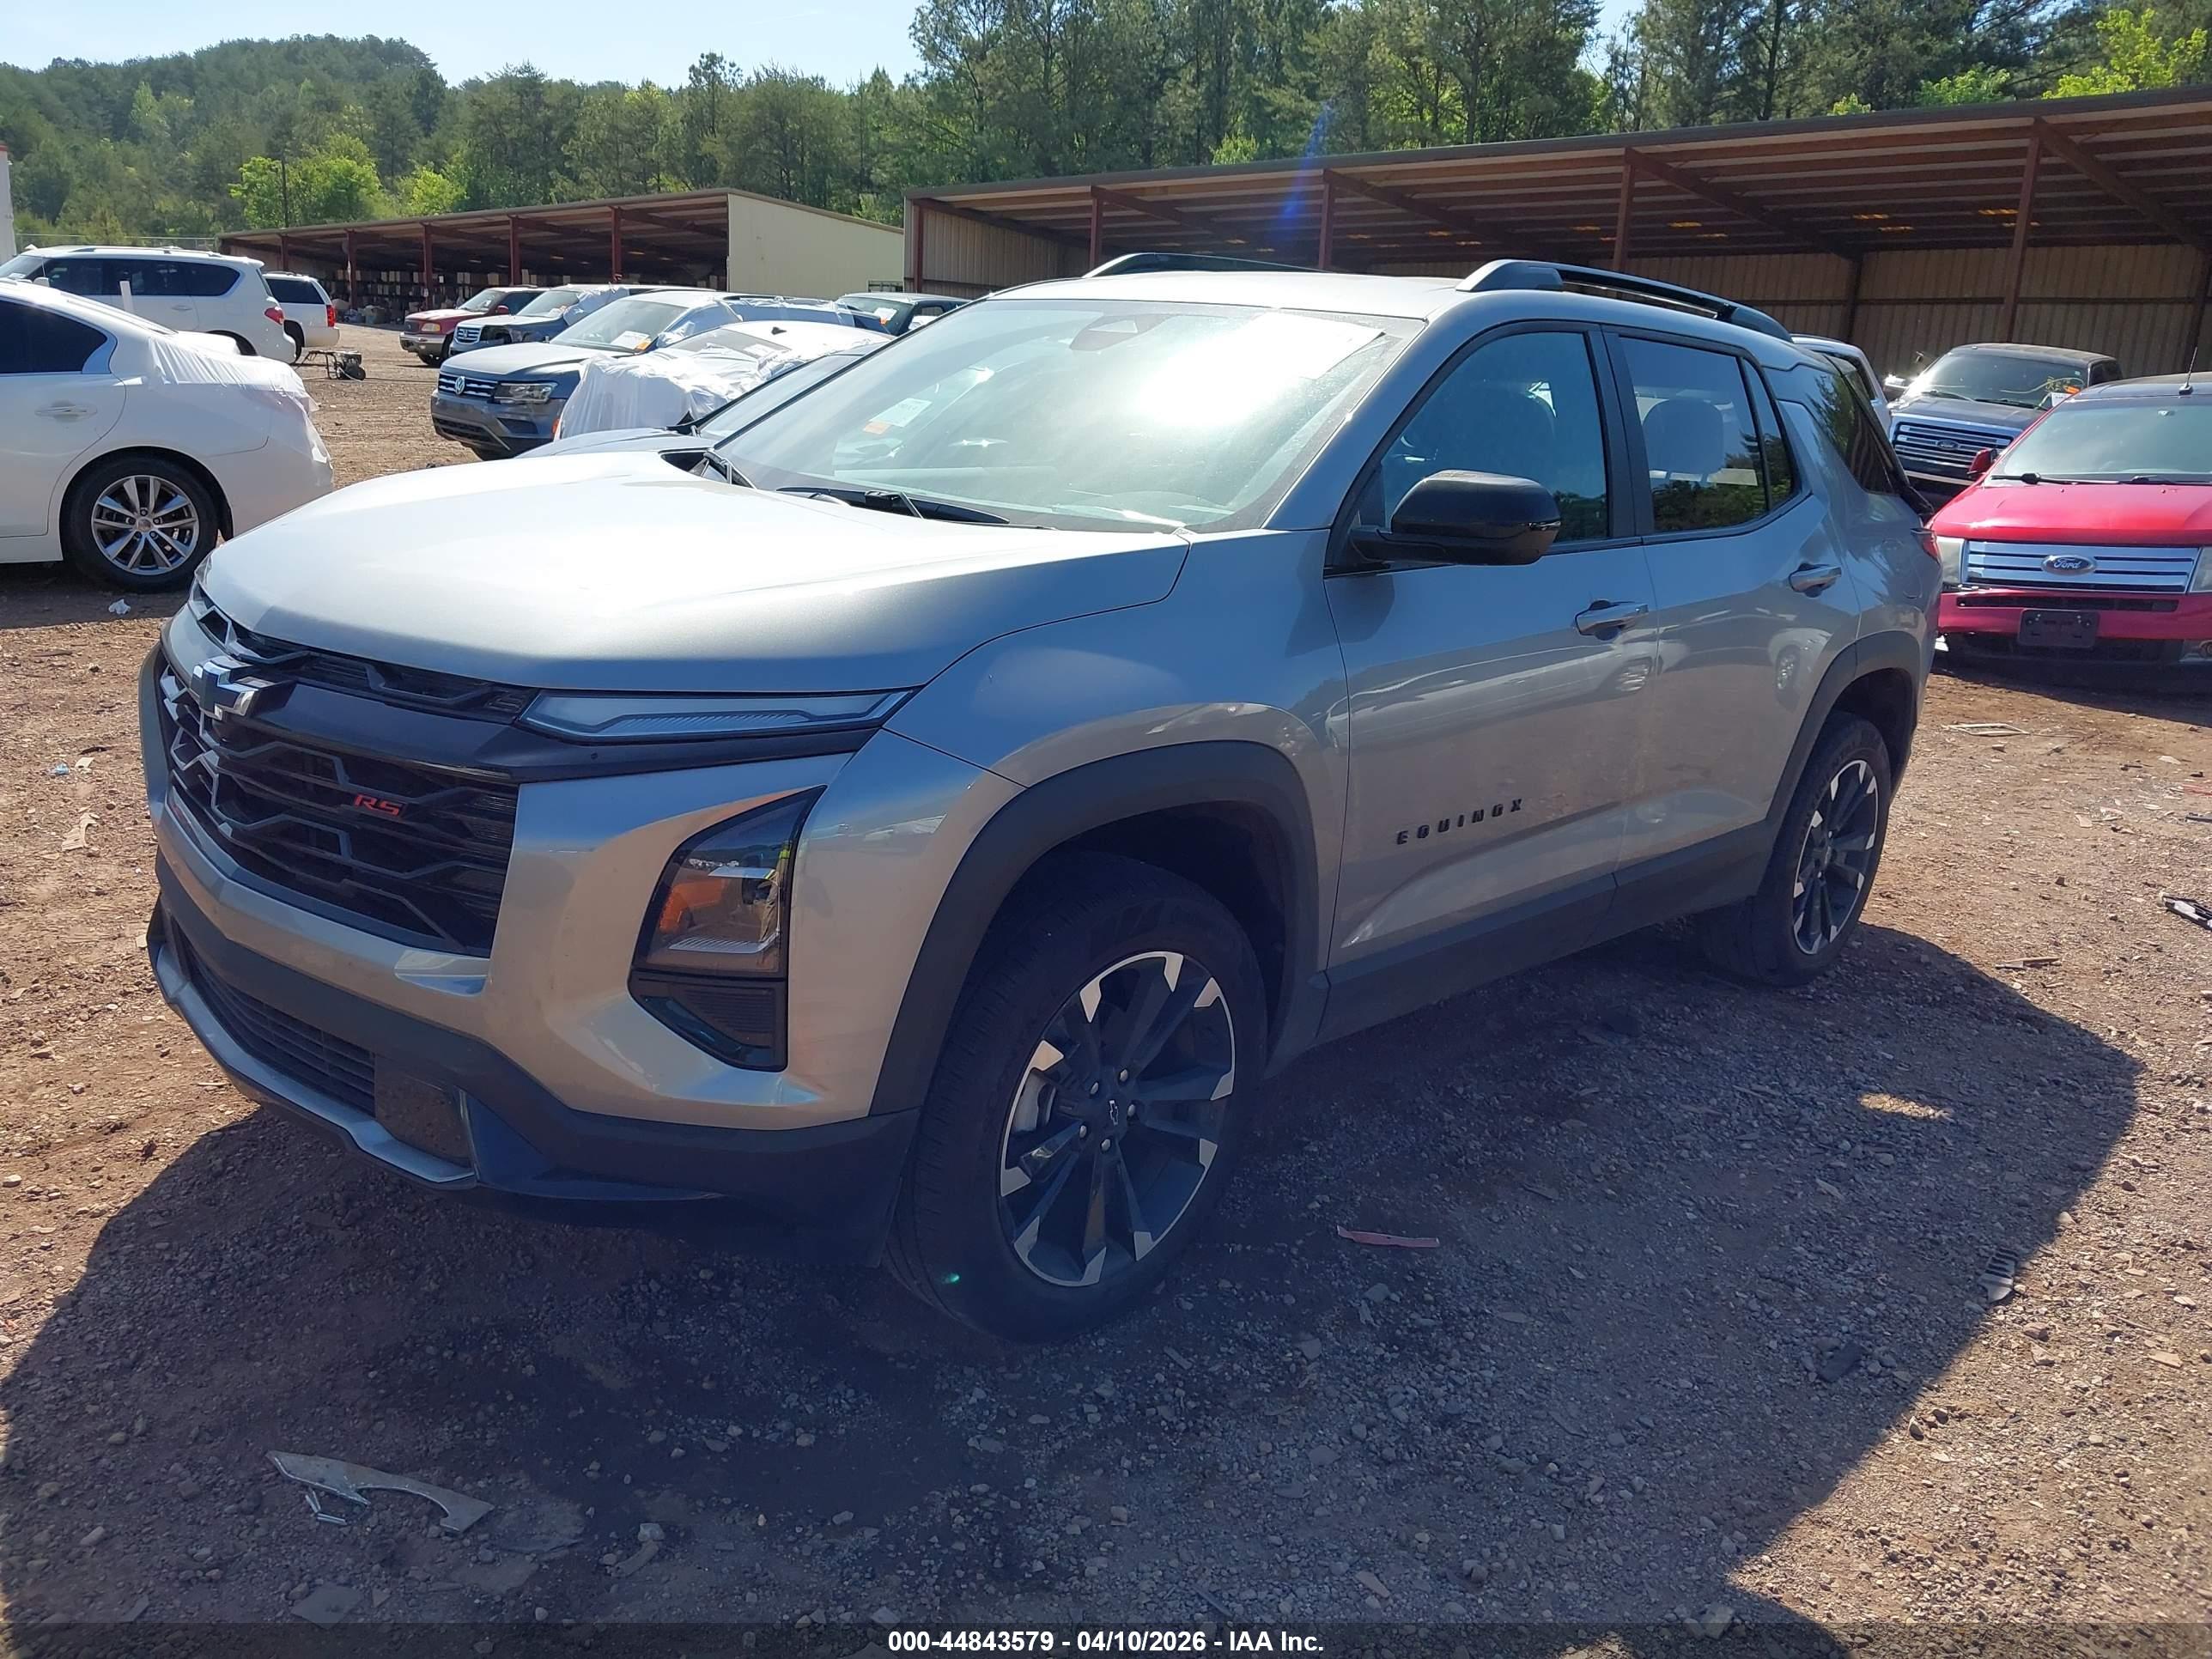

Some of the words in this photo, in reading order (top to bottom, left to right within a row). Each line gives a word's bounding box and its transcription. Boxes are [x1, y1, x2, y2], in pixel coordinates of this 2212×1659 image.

[2053, 557, 2082, 569] Ford
[354, 794, 404, 816] RS
[1395, 798, 1522, 845] EQUINOX
